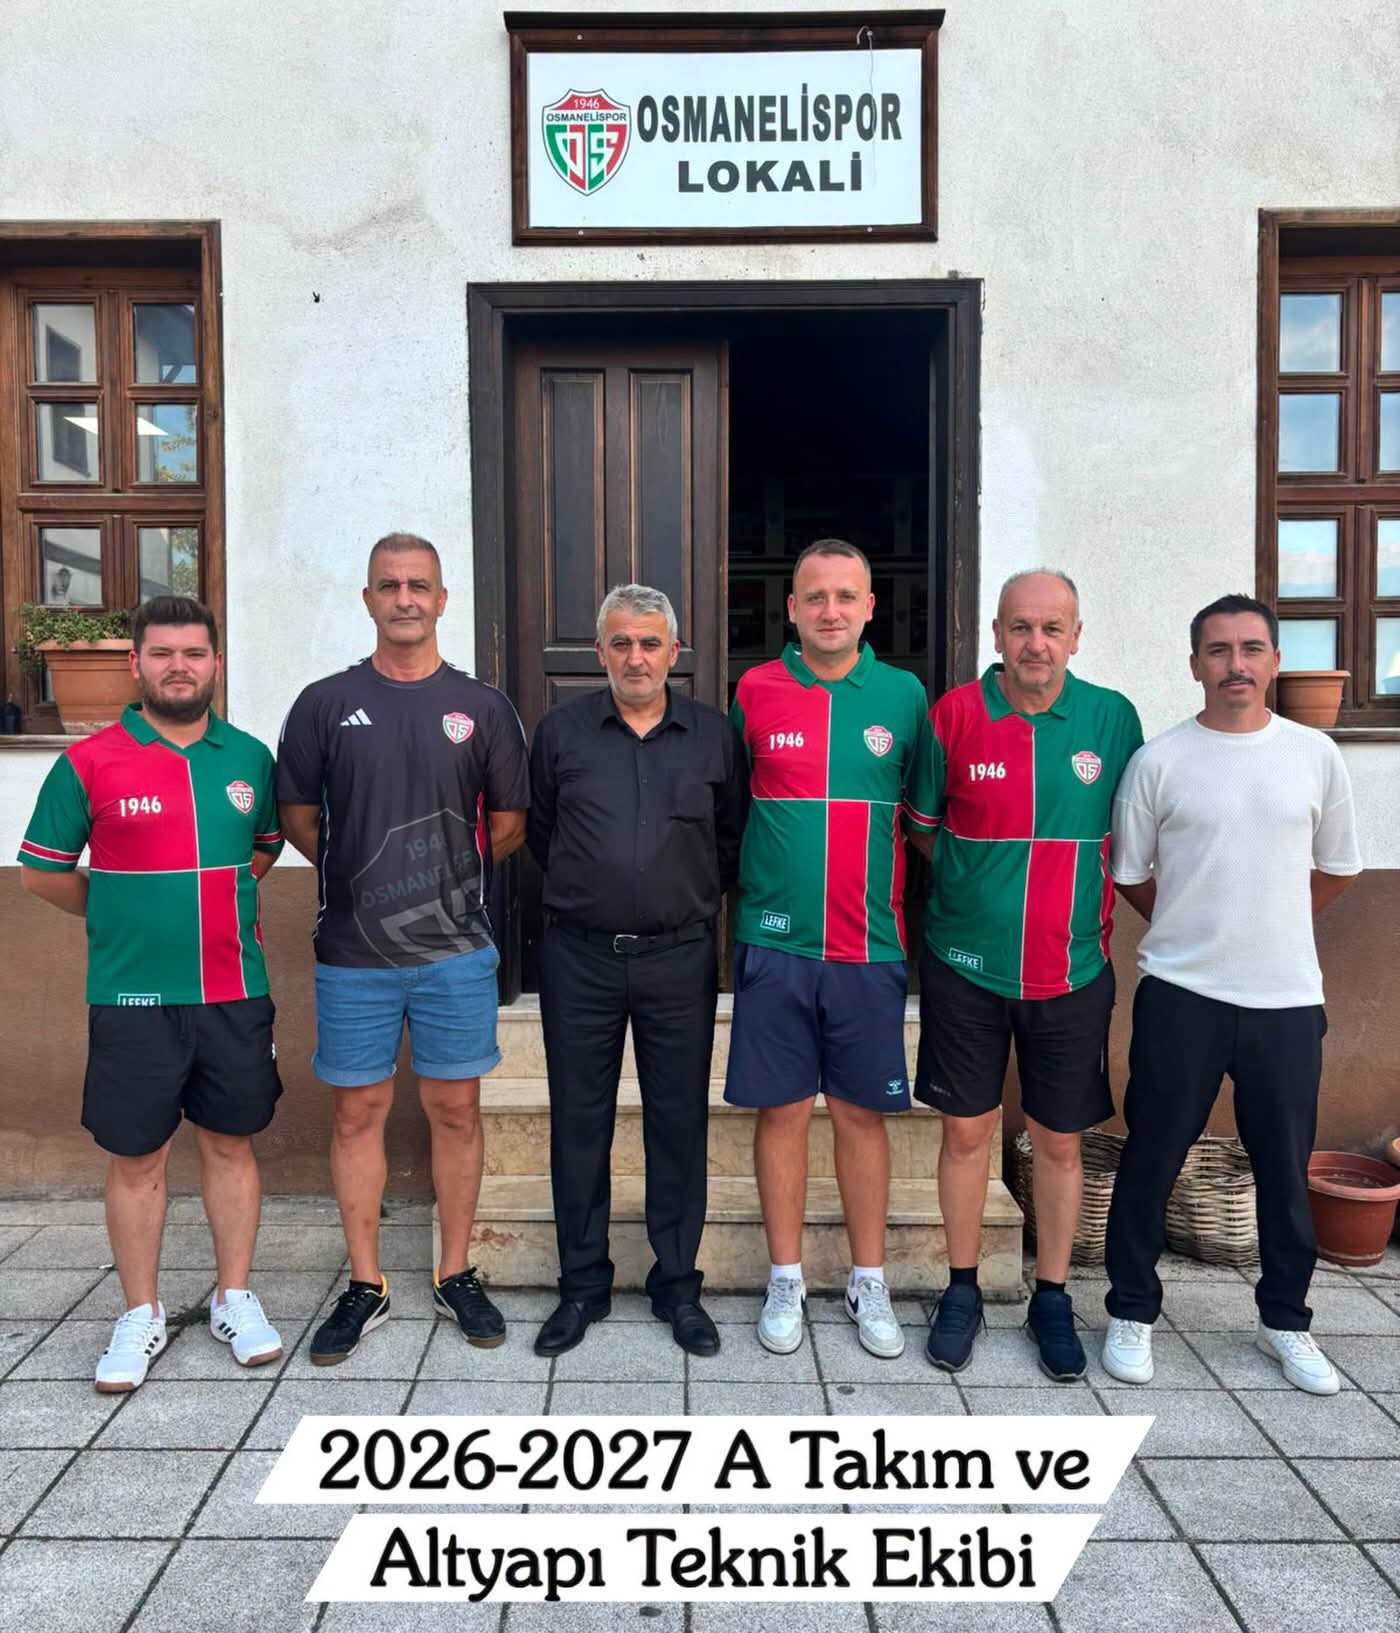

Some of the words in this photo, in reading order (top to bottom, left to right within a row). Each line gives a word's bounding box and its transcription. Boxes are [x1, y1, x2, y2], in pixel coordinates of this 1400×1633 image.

[573, 98, 600, 109] 1946
[637, 83, 901, 143] OSMANELİSPOR
[546, 111, 627, 122] OSMANELİSPOR
[678, 151, 862, 193] LOKALİ
[769, 732, 804, 751] 1946
[969, 761, 1006, 782] 1946
[119, 796, 162, 817] 1946
